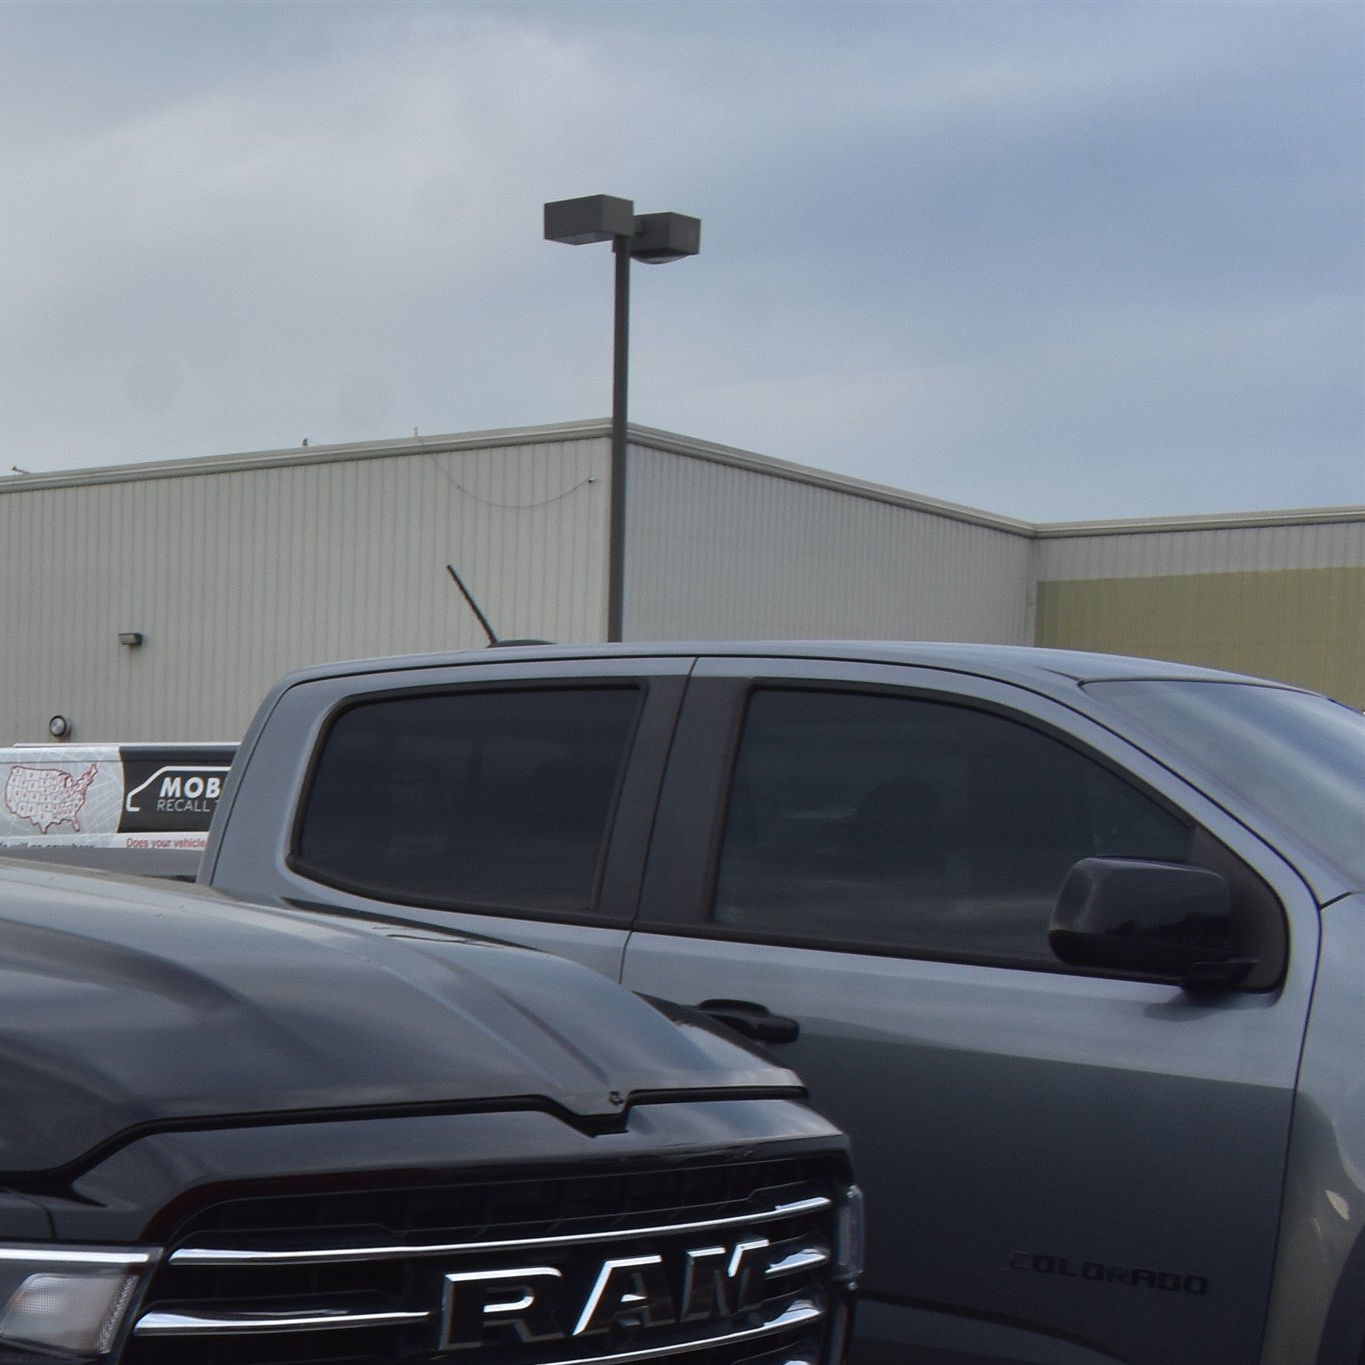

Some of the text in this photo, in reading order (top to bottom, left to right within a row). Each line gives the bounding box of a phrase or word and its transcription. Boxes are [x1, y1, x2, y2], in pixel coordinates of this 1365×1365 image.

[160, 777, 220, 798] MOB
[157, 799, 210, 812] RECALL
[127, 838, 148, 847] Does
[152, 840, 171, 848] your
[1009, 1252, 1208, 1296] COLORADO
[438, 1238, 770, 1350] RAM
